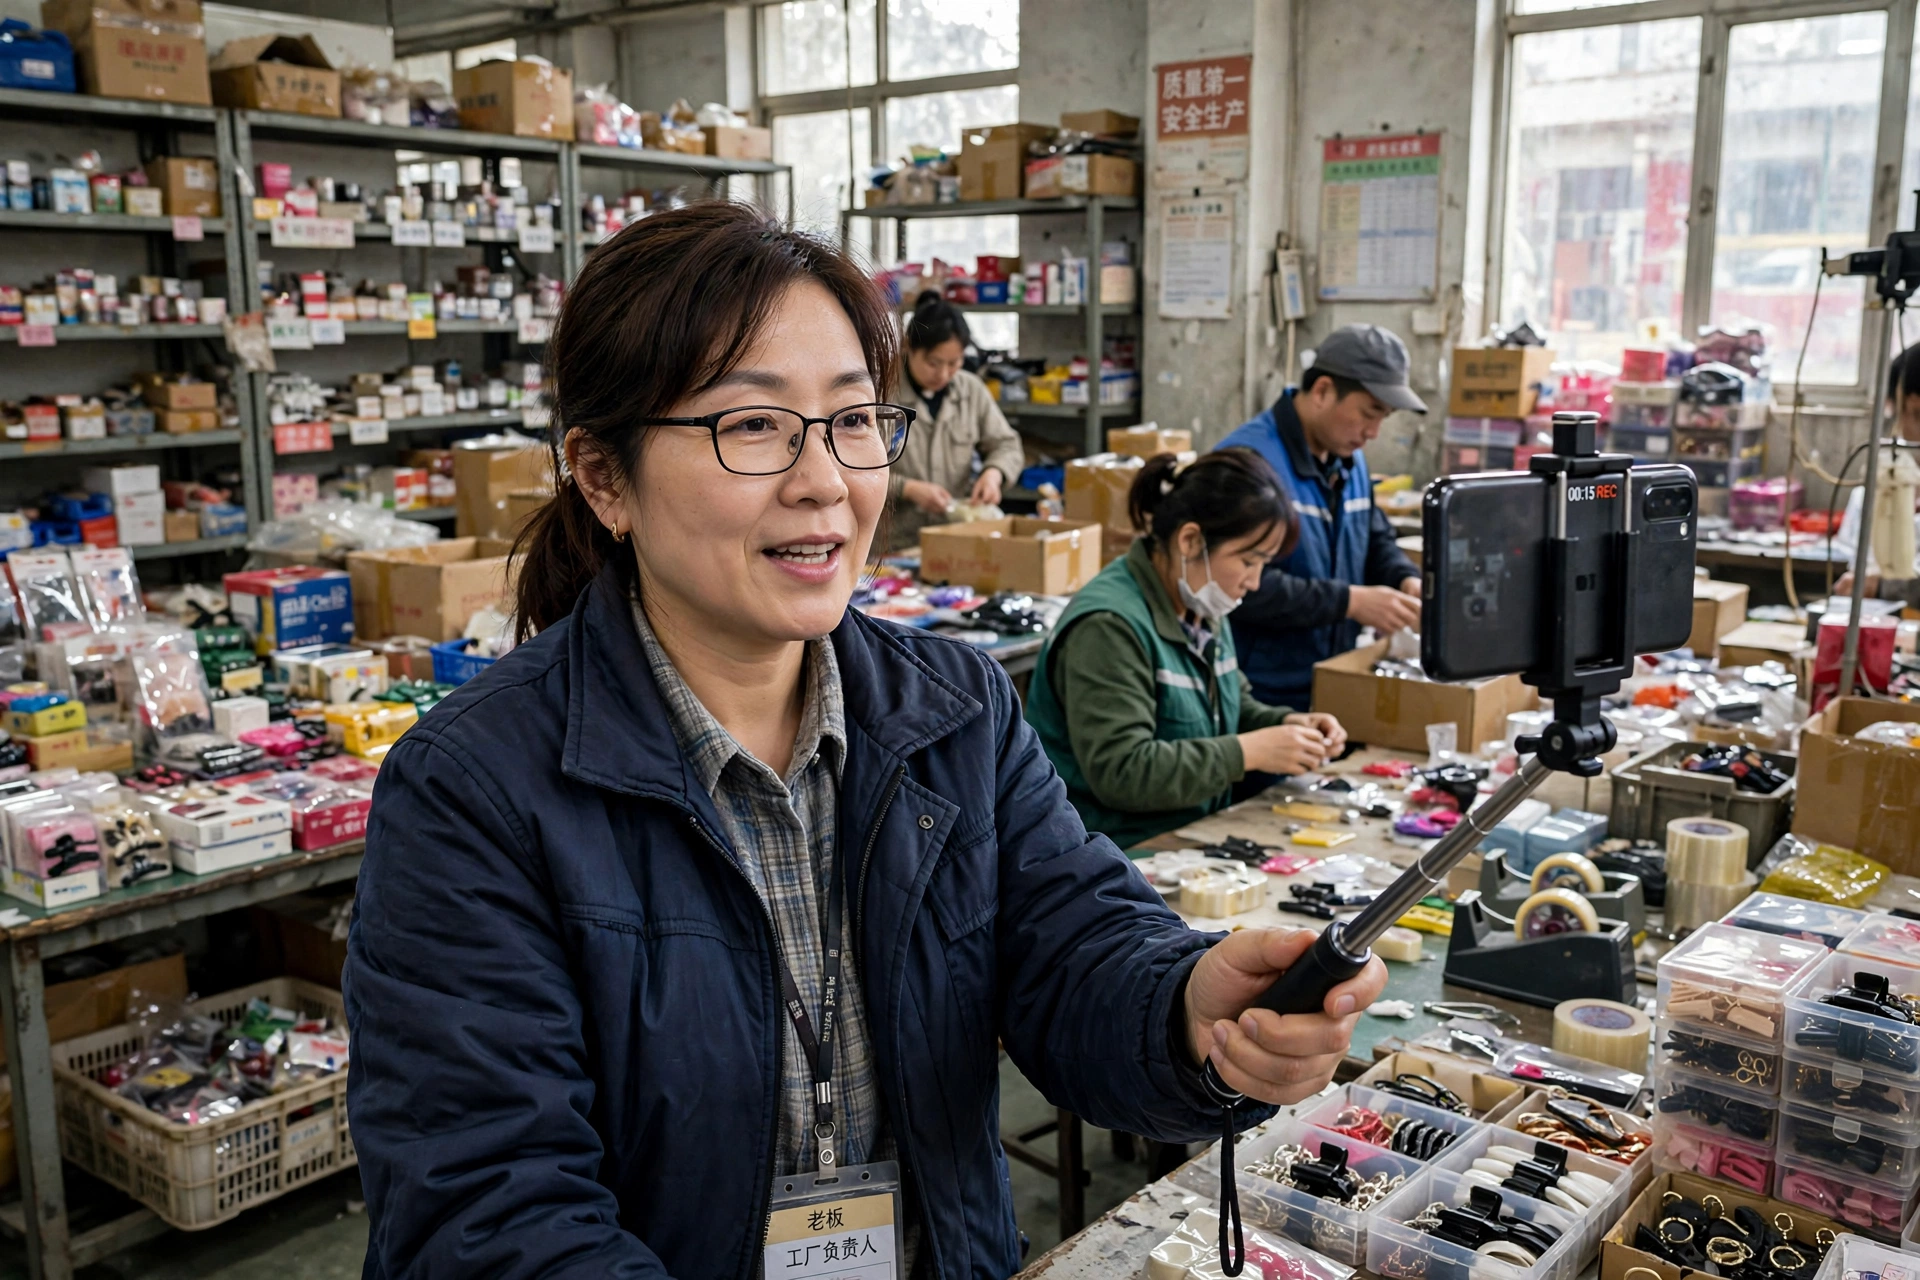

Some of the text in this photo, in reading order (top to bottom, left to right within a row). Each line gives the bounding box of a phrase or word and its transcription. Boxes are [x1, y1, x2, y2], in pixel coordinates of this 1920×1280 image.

[1162, 66, 1245, 100] 质量第一
[1161, 99, 1245, 134] 安全生产
[1568, 484, 1618, 501] 00:15 REC
[807, 1207, 844, 1231] 老板
[786, 1234, 877, 1268] 工厂负责人
